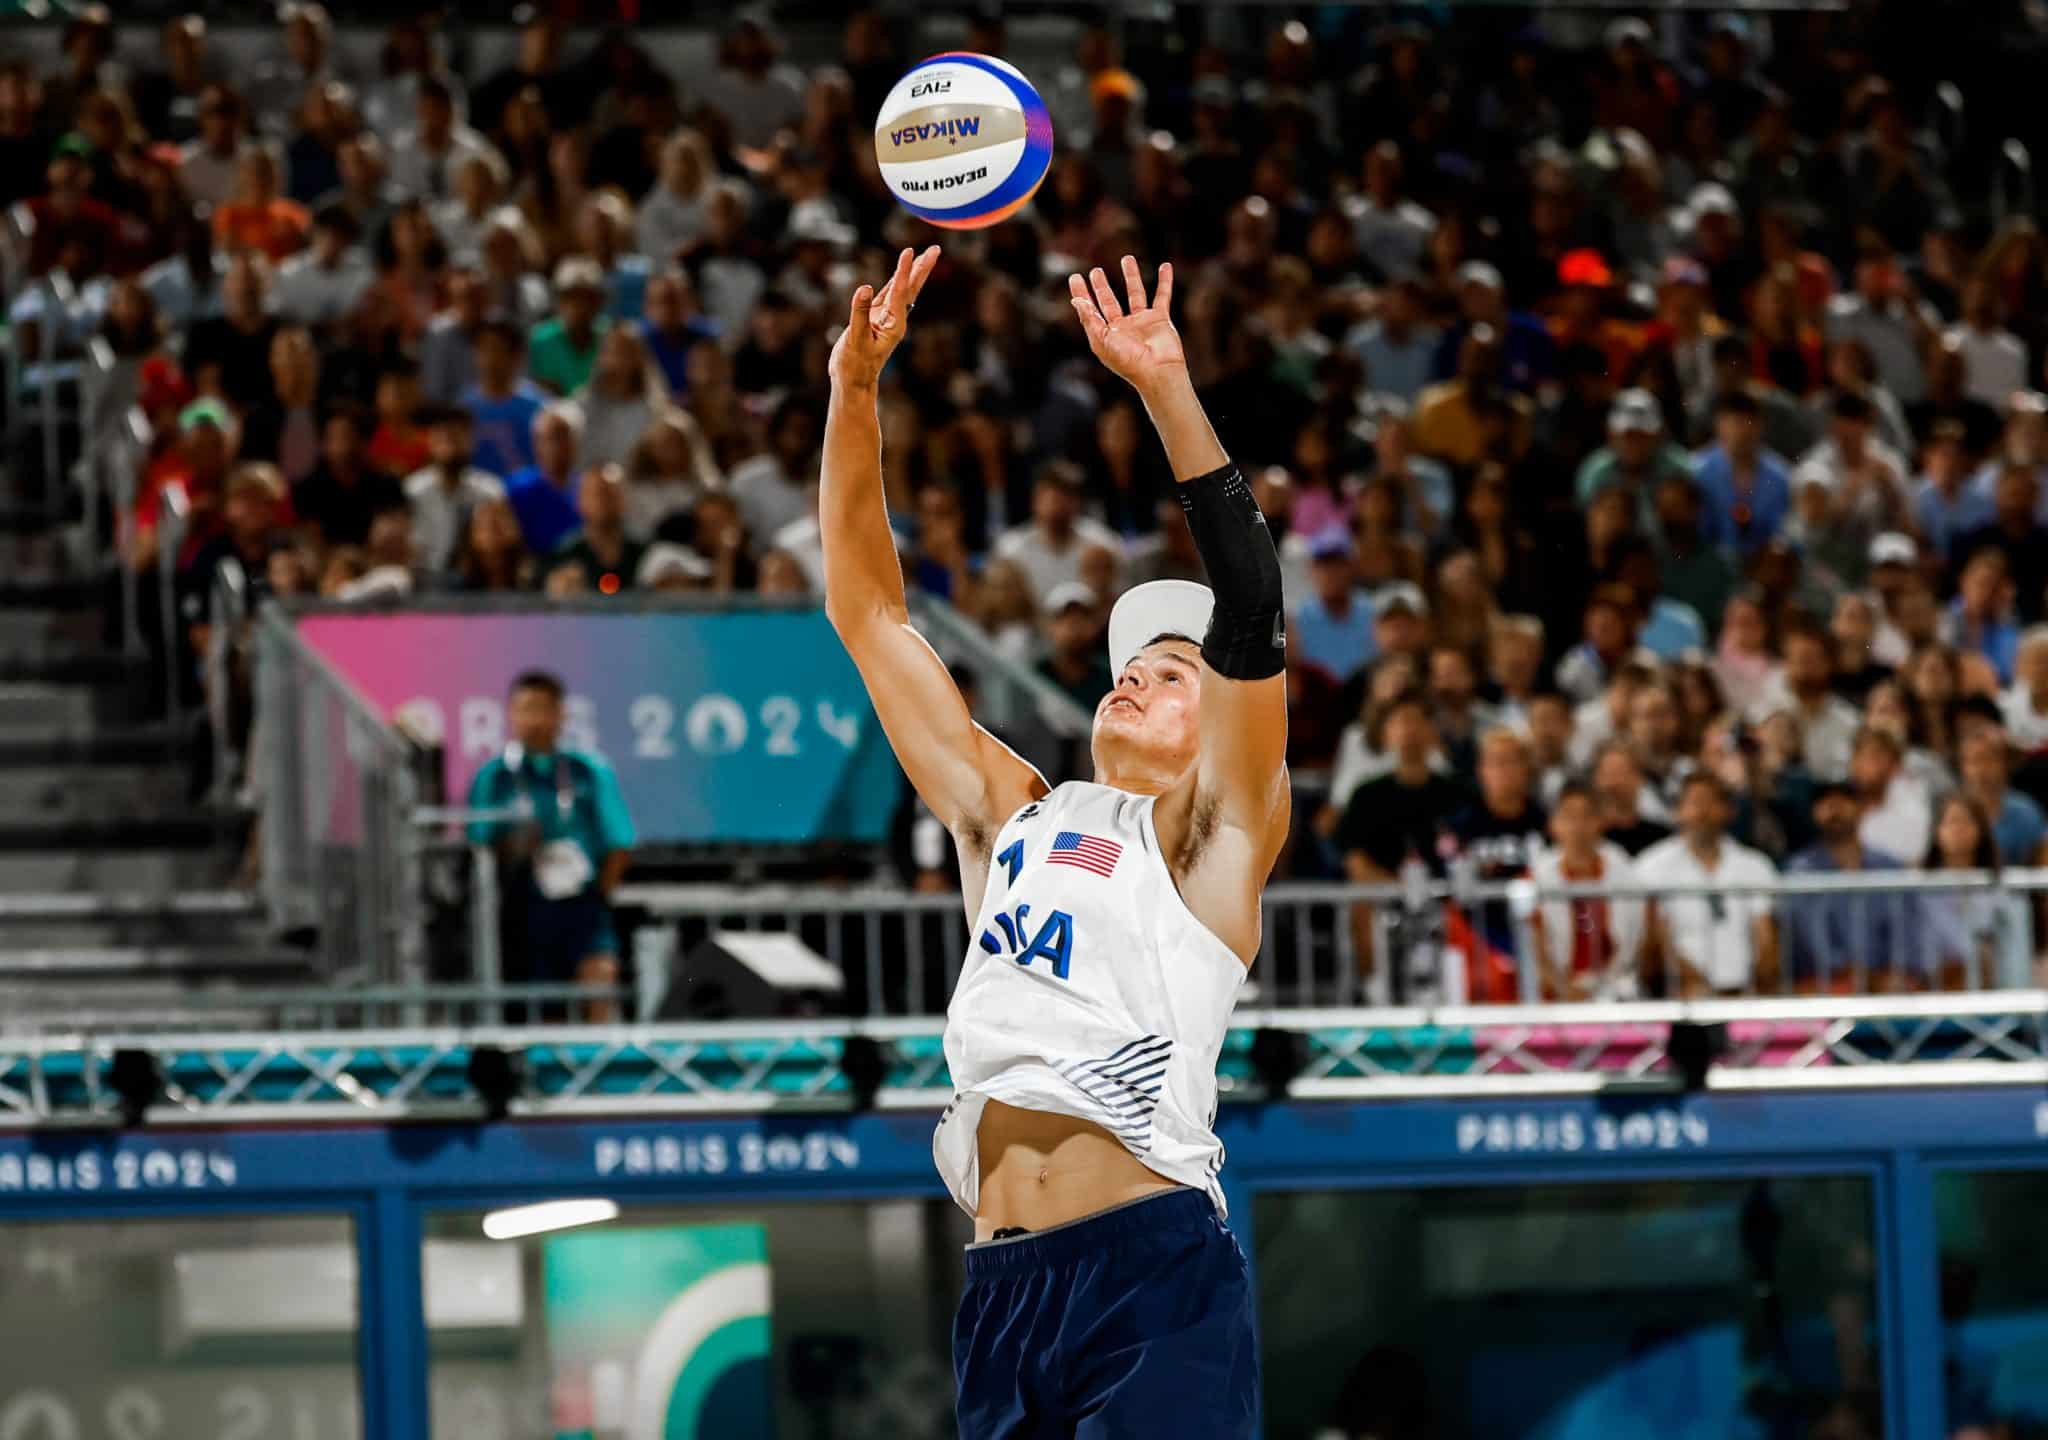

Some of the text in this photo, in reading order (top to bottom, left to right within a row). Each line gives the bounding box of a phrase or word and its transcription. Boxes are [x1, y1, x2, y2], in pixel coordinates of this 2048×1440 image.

[890, 116, 980, 146] MIKASA
[901, 165, 988, 191] BEACH PRO
[629, 693, 858, 757] 2024
[1457, 1108, 1708, 1151] PARIS 2024
[0, 1150, 236, 1190] ARIS 2024
[595, 1132, 859, 1175] PARIS 2024
